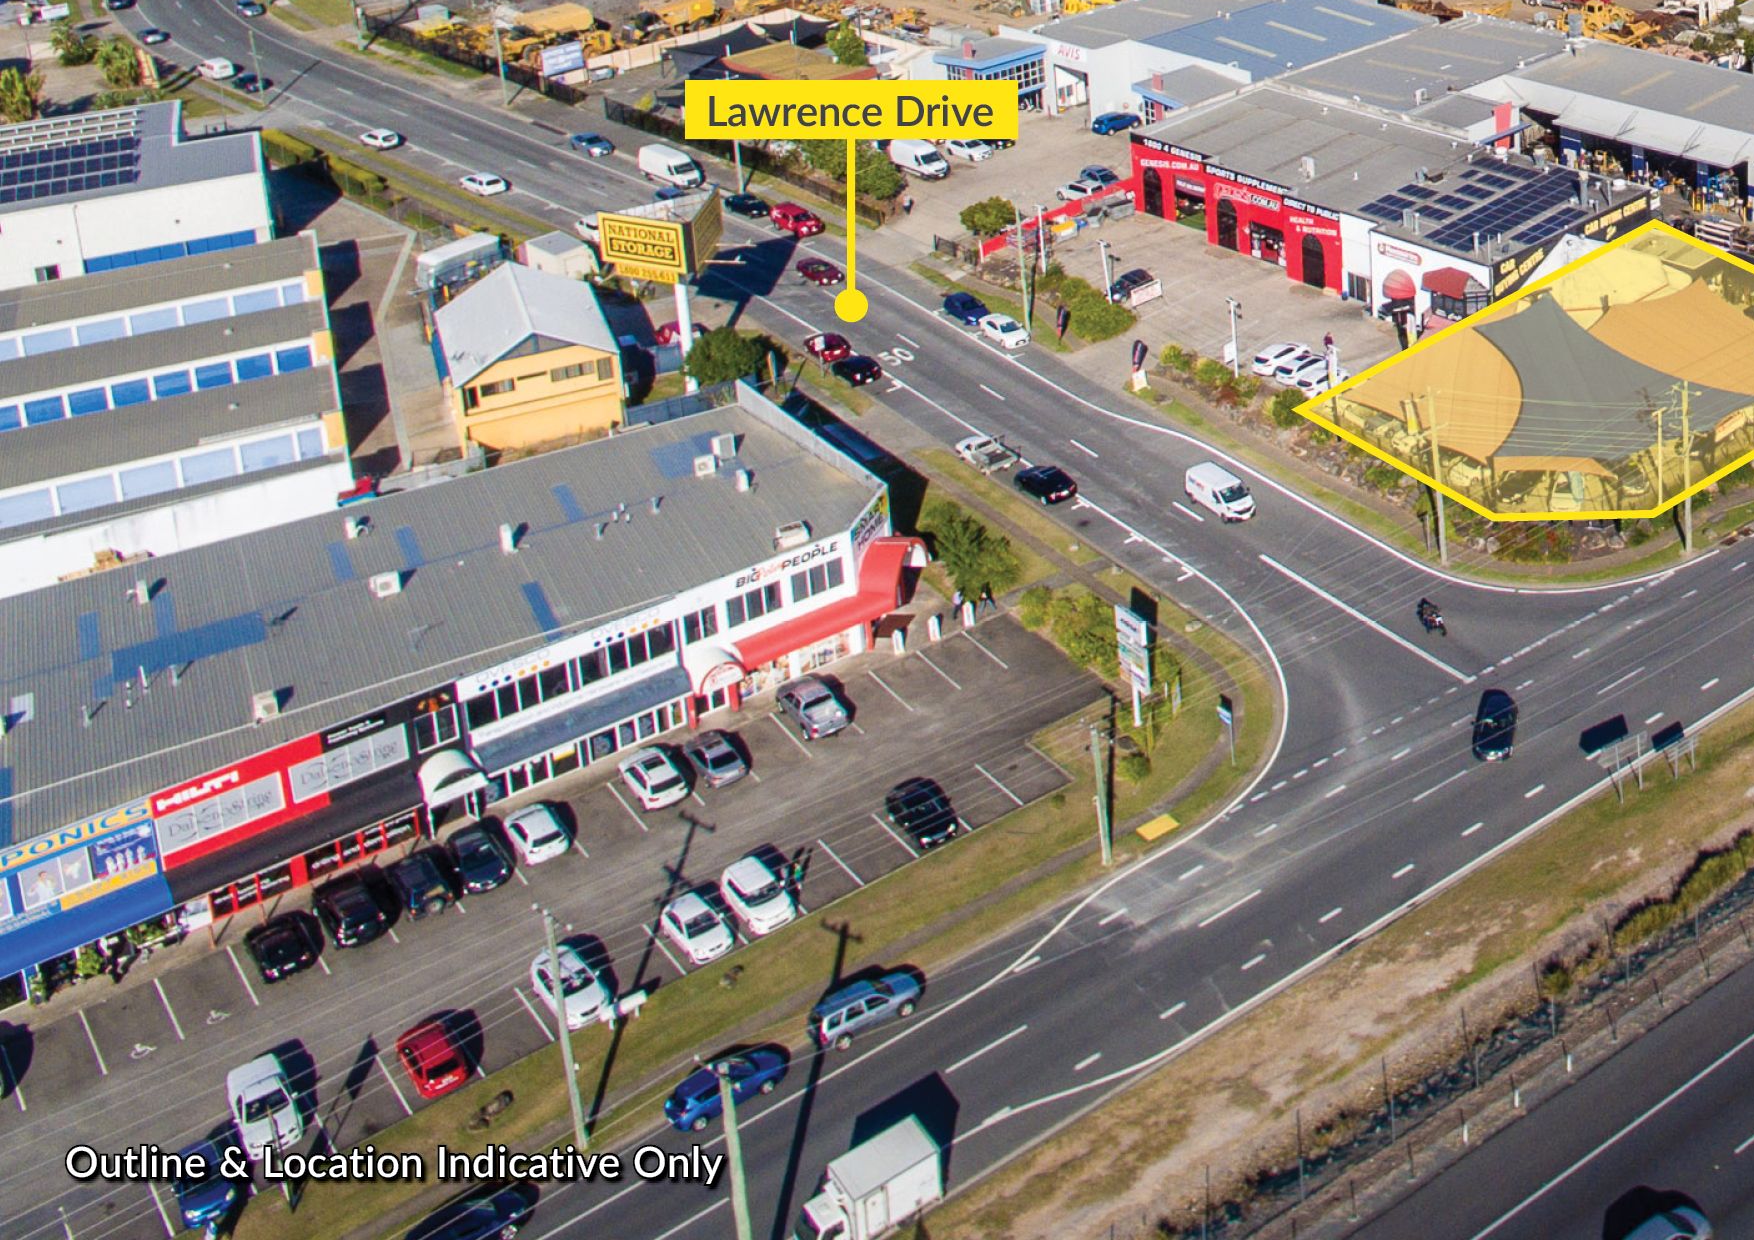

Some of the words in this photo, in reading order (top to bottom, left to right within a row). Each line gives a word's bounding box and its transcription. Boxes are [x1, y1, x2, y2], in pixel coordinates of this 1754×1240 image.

[1056, 45, 1081, 60] AVIS
[1206, 164, 1235, 180] SPORTS
[608, 224, 675, 243] NATIONAL
[1584, 220, 1599, 235] CAR
[611, 239, 674, 259] STORAGE
[1501, 259, 1516, 274] CAR
[877, 347, 915, 366] 50
[736, 568, 761, 588] BIG
[781, 542, 838, 571] PEOPLE
[156, 770, 239, 811] HILTI
